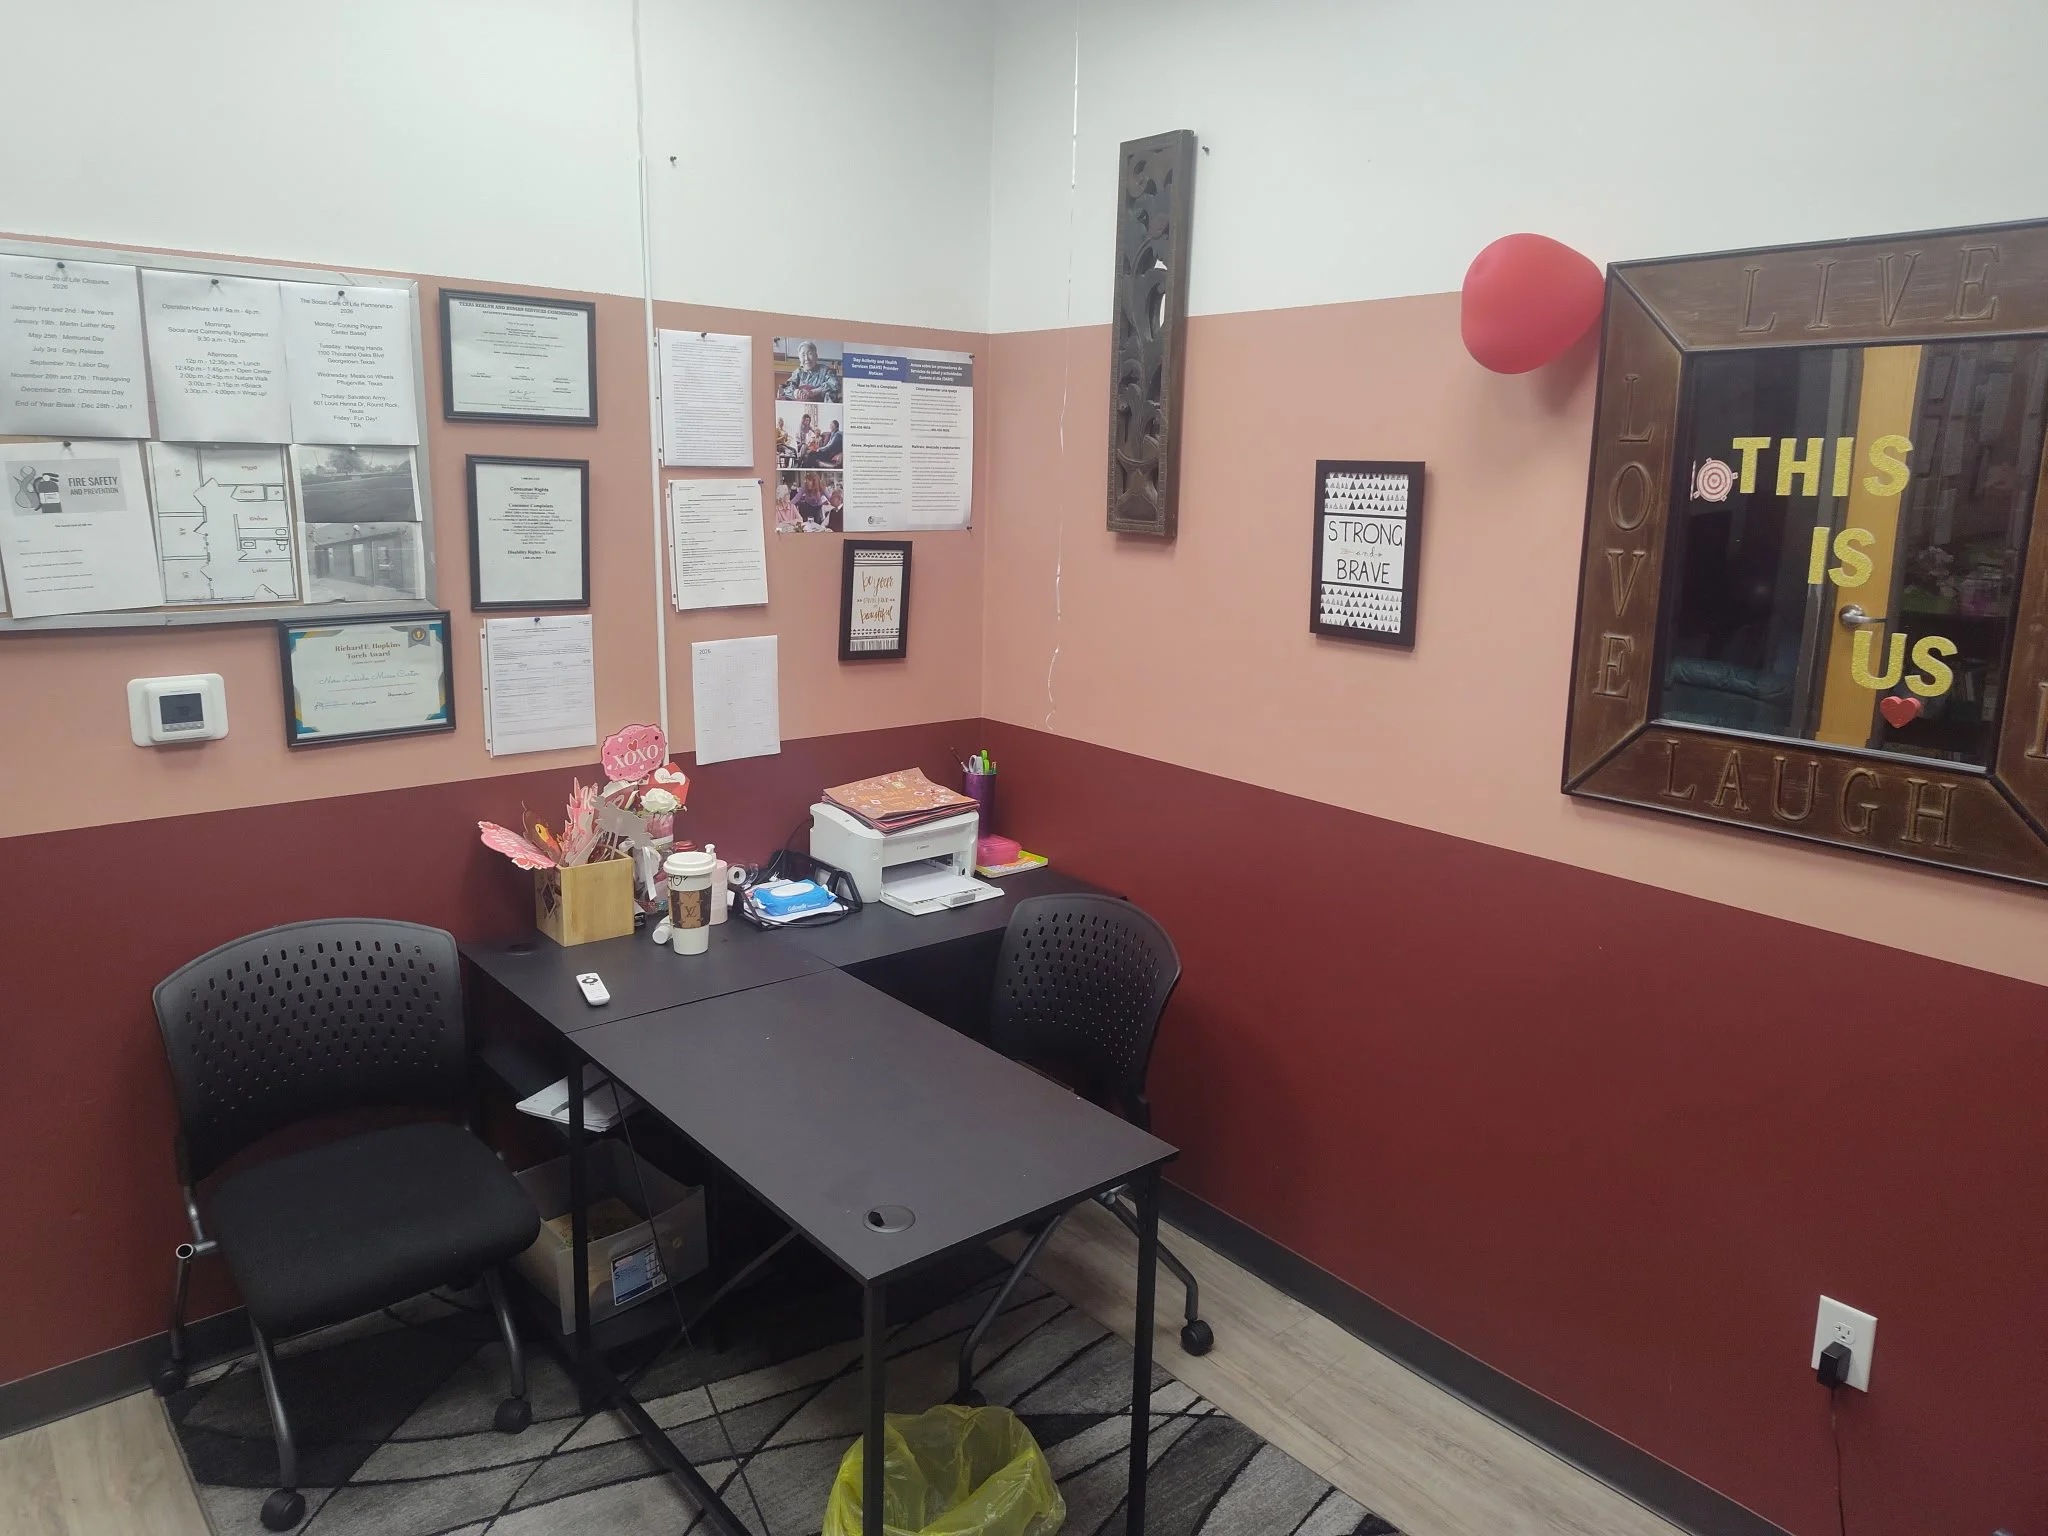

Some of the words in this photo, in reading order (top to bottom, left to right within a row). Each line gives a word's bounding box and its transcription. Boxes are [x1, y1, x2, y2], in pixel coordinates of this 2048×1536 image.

[1738, 244, 2000, 334] LIVE
[1732, 435, 1914, 497] THIS
[68, 477, 87, 487] FIRE
[88, 476, 118, 487] SAFETY
[83, 487, 119, 495] PREVENTION
[1328, 520, 1403, 547] STRONG
[1592, 375, 1654, 698] LOVE
[1807, 526, 1876, 588] IS
[1336, 558, 1390, 585] BRAVE
[335, 644, 363, 652] Richard
[372, 642, 400, 650] Hopkins
[369, 650, 391, 658] Award
[1851, 630, 1959, 698] US
[613, 744, 659, 770] XOXO
[1661, 739, 1958, 850] LAUGH
